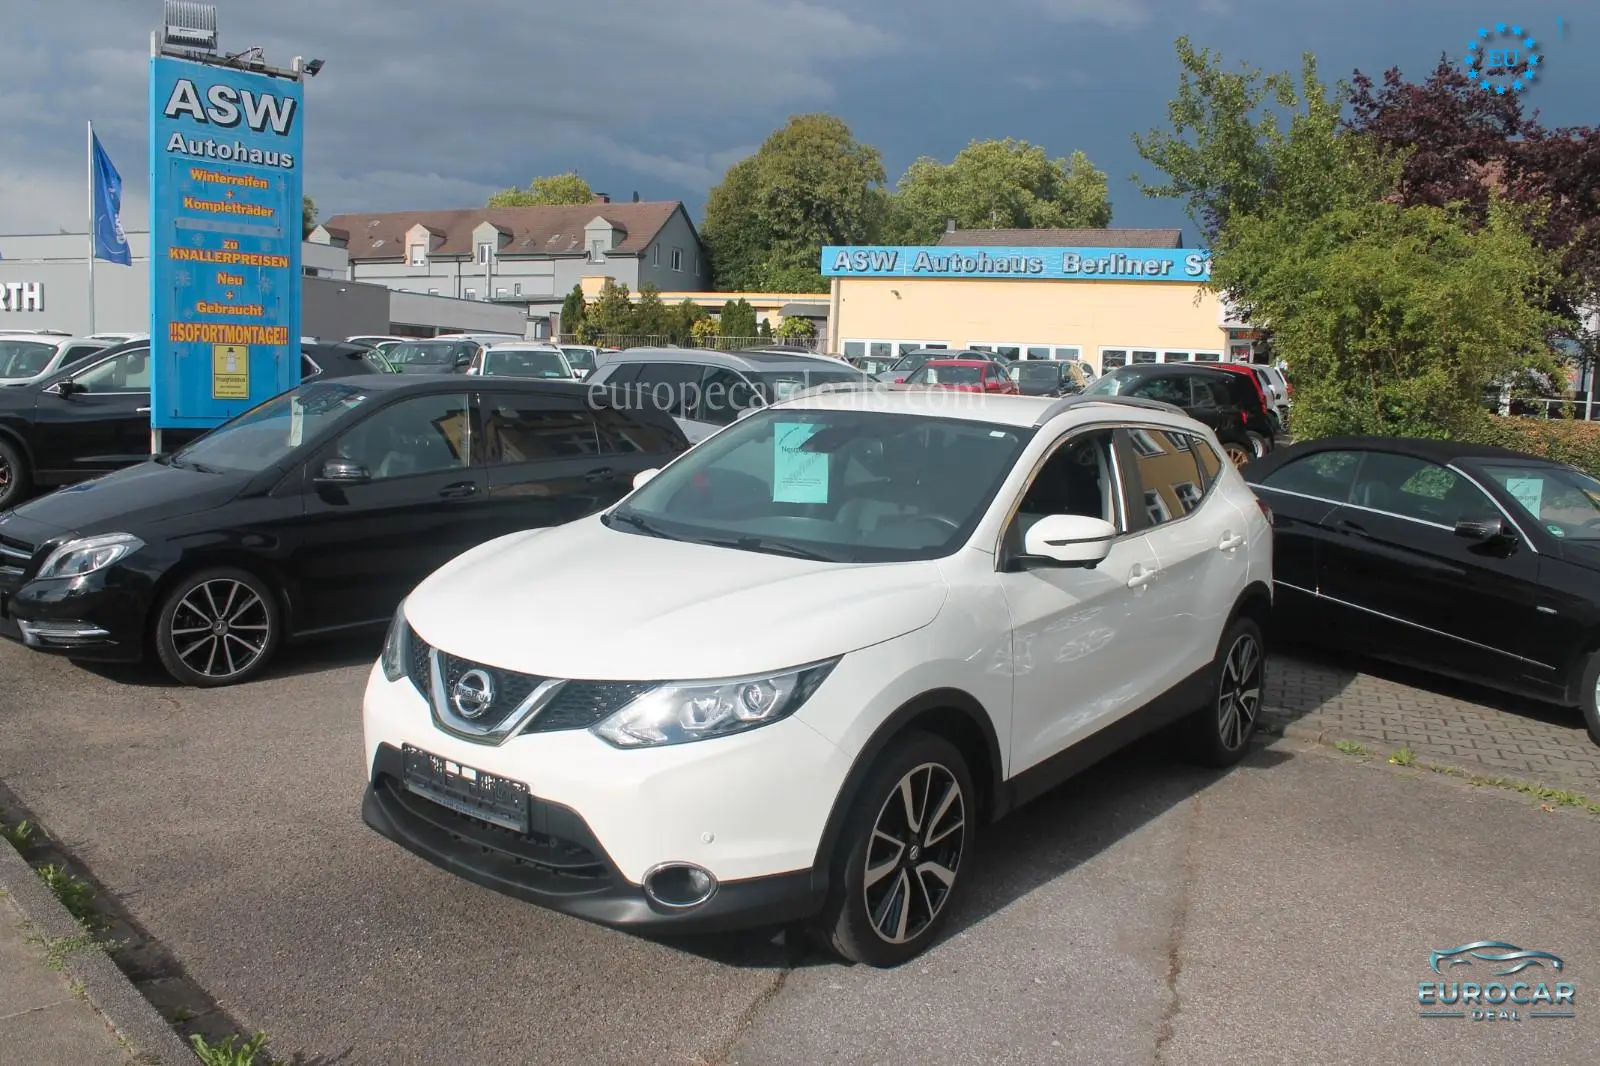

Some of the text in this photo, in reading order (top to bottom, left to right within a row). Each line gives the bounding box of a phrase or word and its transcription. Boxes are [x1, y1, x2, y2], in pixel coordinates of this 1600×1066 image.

[164, 78, 297, 136] ASW
[167, 132, 294, 169] Autohaus
[190, 166, 269, 189] Winterreifen
[183, 196, 274, 218] Kompletträder
[169, 247, 289, 268] KNALLERPREISEN
[832, 250, 898, 272] ASW
[912, 251, 1043, 274] Autohaus
[1062, 252, 1173, 276] Berliner
[216, 271, 244, 286] Neu
[196, 301, 264, 316] Gebraucht
